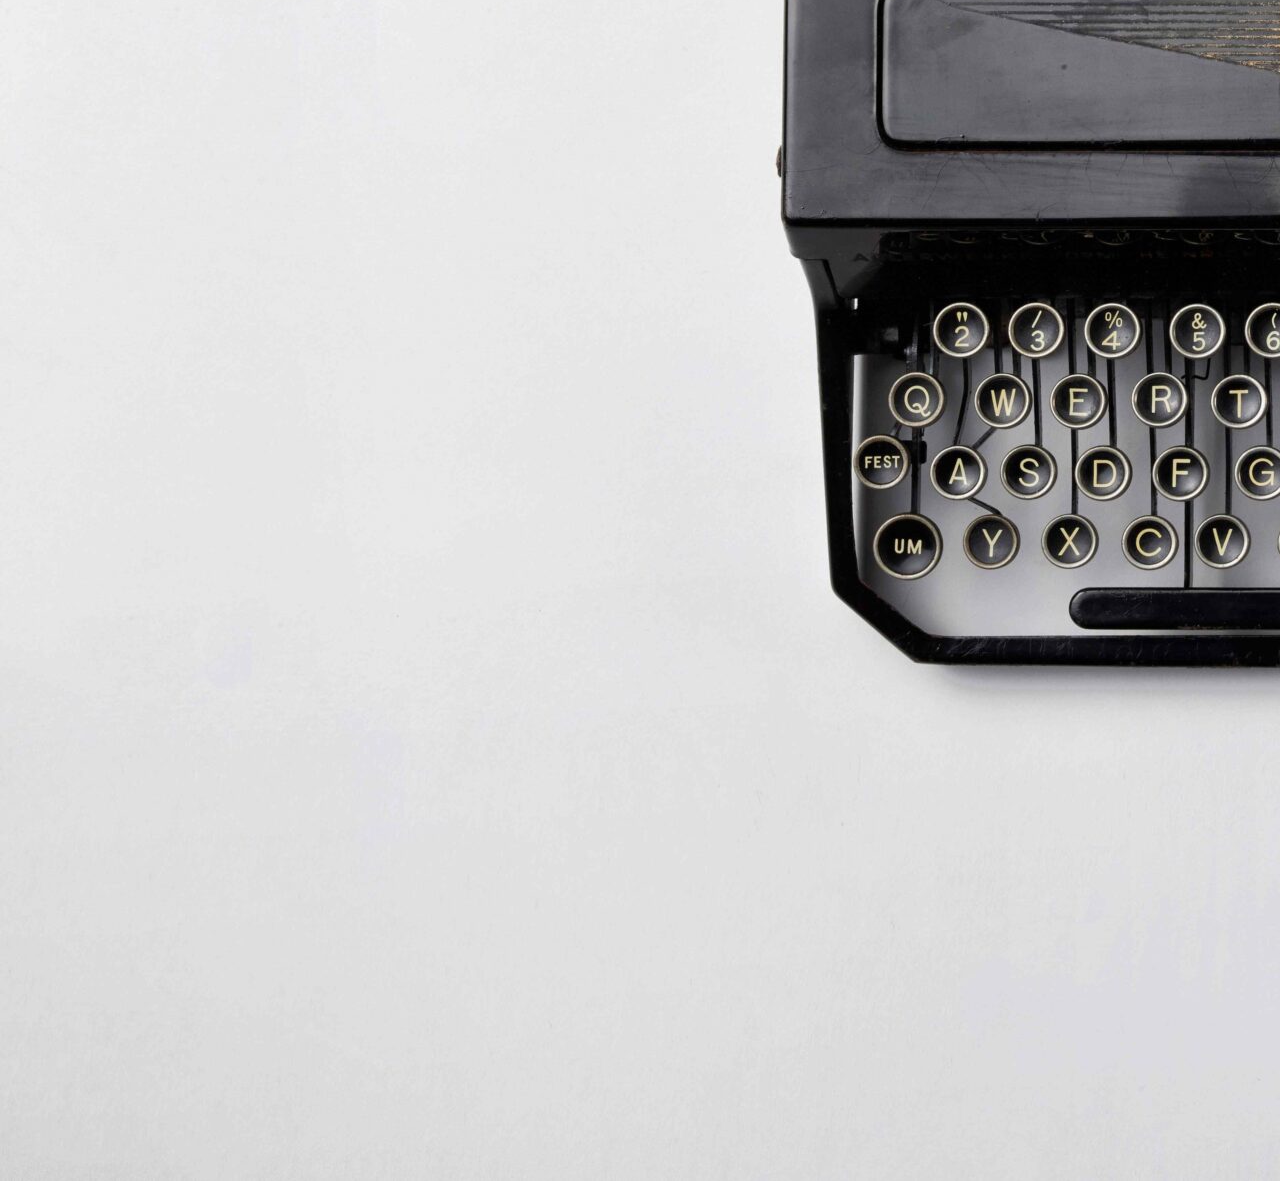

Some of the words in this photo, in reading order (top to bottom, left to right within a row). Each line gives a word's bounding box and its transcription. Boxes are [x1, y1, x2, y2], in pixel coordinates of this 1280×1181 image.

[955, 326, 971, 347] 2
[1031, 330, 1045, 349] 3
[1102, 331, 1122, 349] 4
[1193, 332, 1205, 351] 5
[1267, 331, 1280, 349] 6
[905, 386, 932, 418] Q
[991, 389, 1015, 416] W
[1070, 389, 1090, 417] E
[1152, 386, 1173, 413] R
[1230, 390, 1250, 418] T
[865, 456, 900, 468] FEST
[949, 458, 968, 486] A
[1019, 458, 1040, 487] S
[1094, 460, 1117, 488] D
[1173, 459, 1191, 488] F
[1249, 458, 1274, 488] G
[895, 539, 921, 554] UM
[983, 529, 1002, 557] Y
[1059, 528, 1080, 556] X
[1136, 529, 1163, 557] C
[1213, 529, 1234, 557] V
